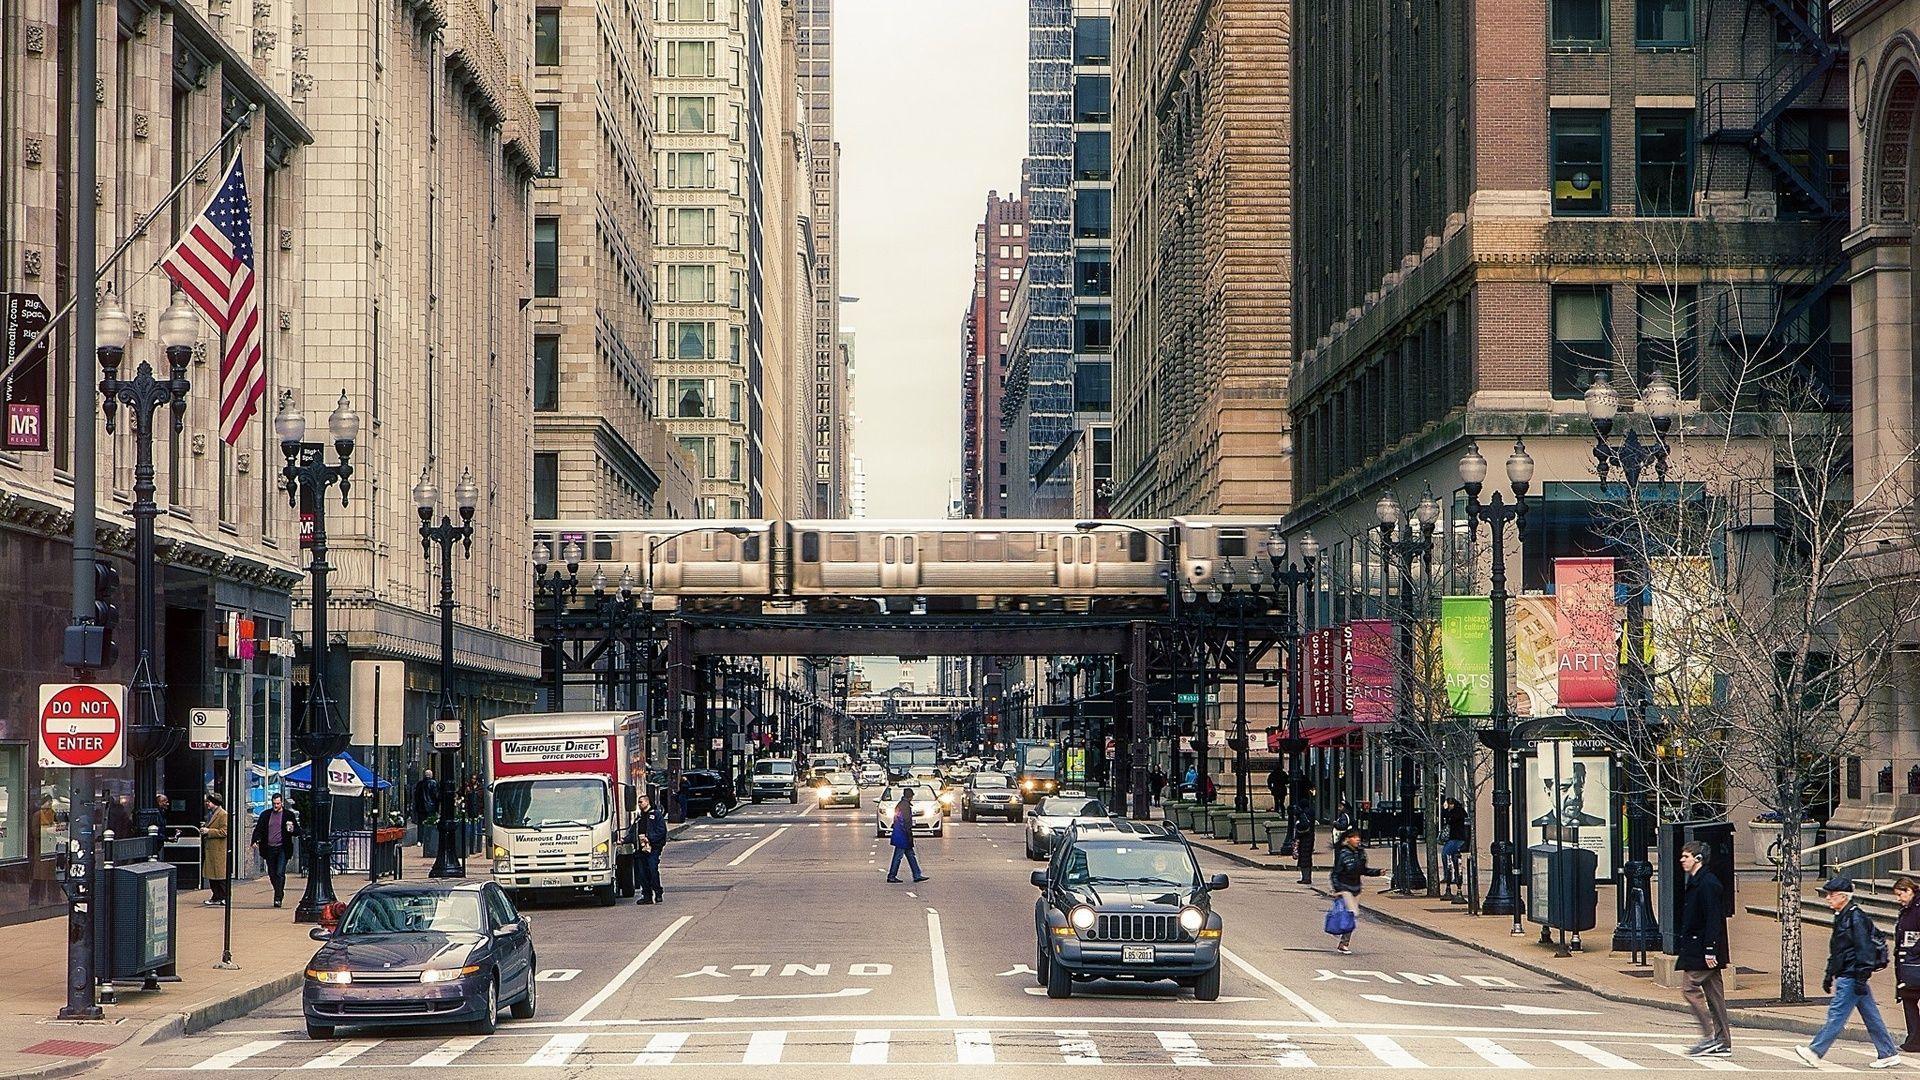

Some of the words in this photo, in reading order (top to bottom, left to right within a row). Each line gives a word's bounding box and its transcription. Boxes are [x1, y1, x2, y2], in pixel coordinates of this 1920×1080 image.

[11, 414, 38, 435] MR
[1559, 653, 1616, 671] ARTS
[1446, 674, 1490, 689] ARTS
[1353, 685, 1393, 699] ARTS
[53, 701, 72, 714] DO
[81, 701, 110, 714] NOT
[58, 737, 103, 751] ENTER
[674, 963, 894, 978] ONLY
[1311, 968, 1528, 989] ONLY
